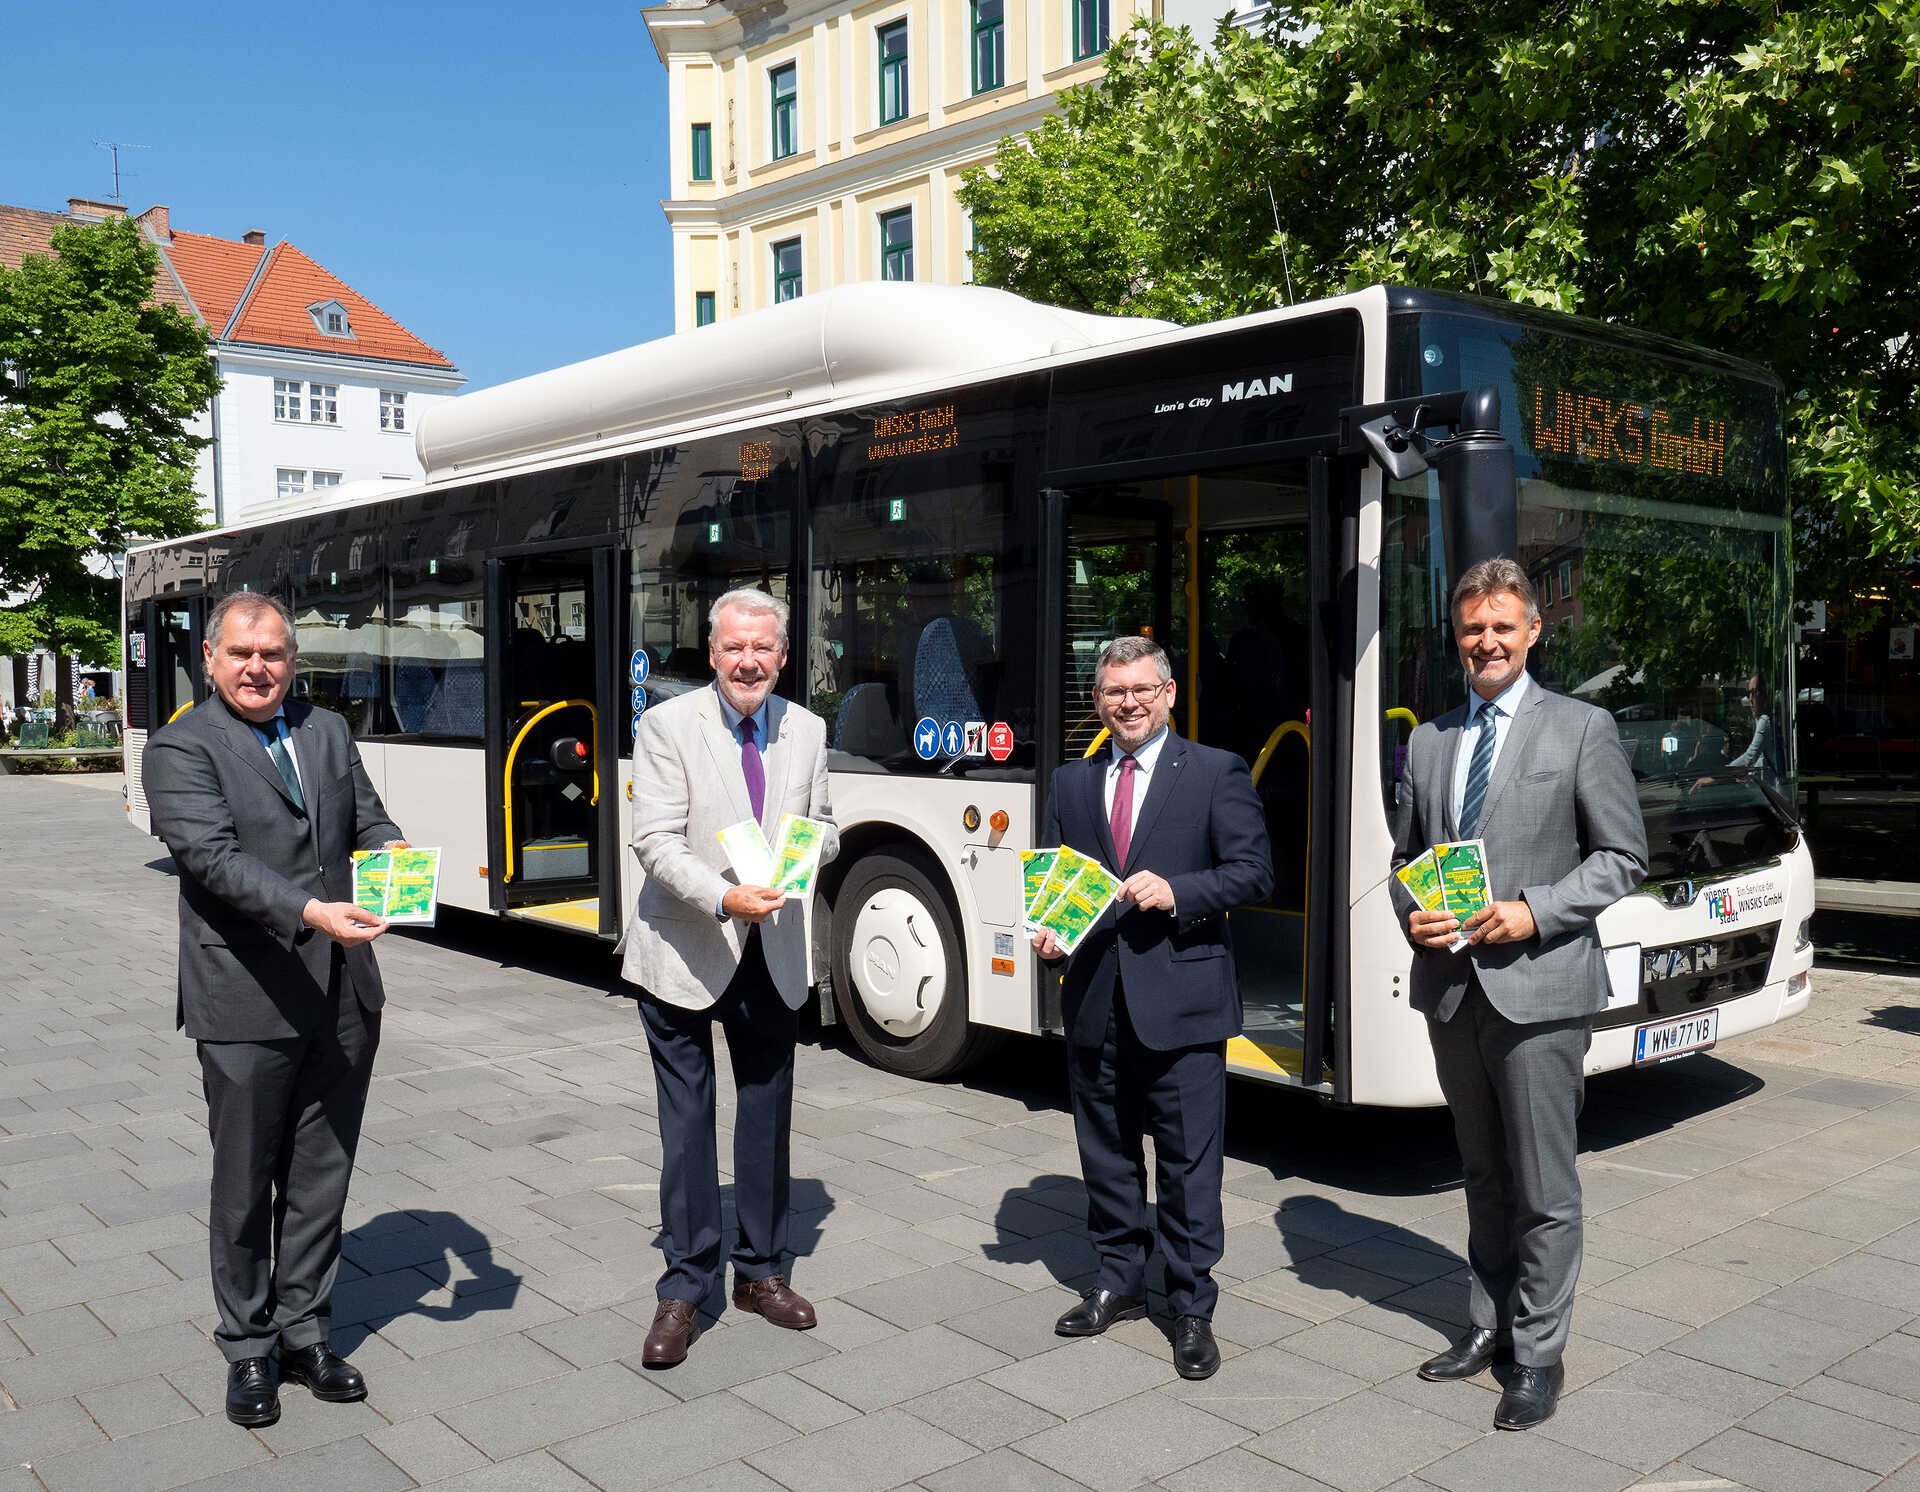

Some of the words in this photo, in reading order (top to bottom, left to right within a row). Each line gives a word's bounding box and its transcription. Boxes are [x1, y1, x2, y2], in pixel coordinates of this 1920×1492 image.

[1221, 373, 1293, 403] MAN
[1154, 401, 1185, 414] Lion's
[1188, 397, 1213, 409] City
[874, 411, 914, 438] WNSKS
[919, 405, 955, 429] GmbH
[1535, 386, 1644, 464] WNSKS
[1650, 409, 1725, 478] GmbH
[868, 426, 958, 460] www.wnsks.at
[1703, 887, 1730, 902] wiener
[1736, 886, 1745, 897] Ein
[1746, 883, 1765, 895] Service
[1766, 881, 1774, 891] der
[1738, 896, 1763, 913] WNSKS
[1763, 891, 1784, 908] GmbH
[1720, 909, 1739, 925] stadt
[1643, 942, 1718, 984] MAN
[1652, 1028, 1670, 1053] WN
[1678, 1022, 1694, 1047] 77
